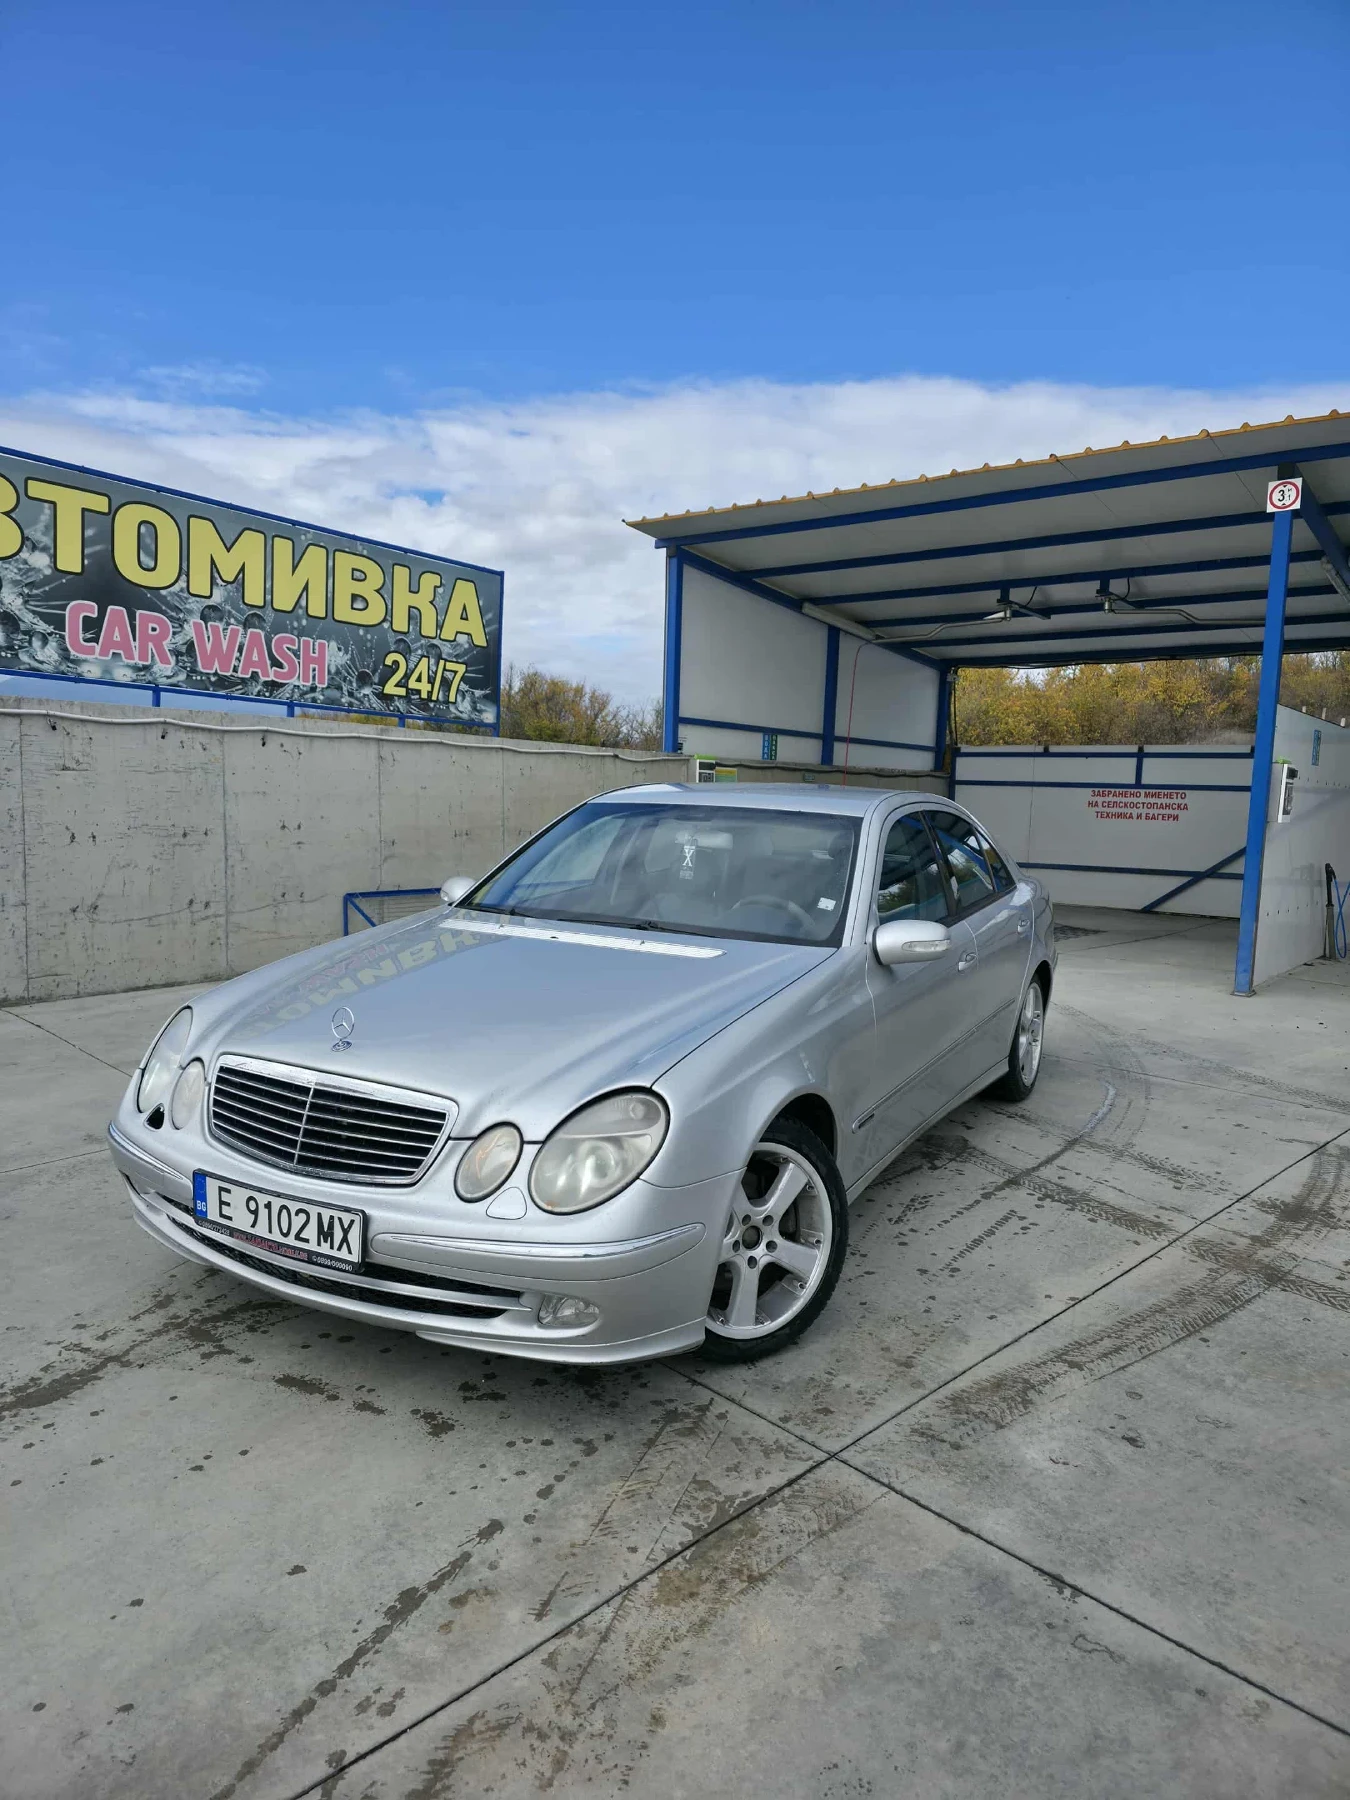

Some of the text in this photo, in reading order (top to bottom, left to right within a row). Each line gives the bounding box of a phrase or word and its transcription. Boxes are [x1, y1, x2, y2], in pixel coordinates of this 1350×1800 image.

[66, 600, 329, 687] CAR WASH
[382, 651, 467, 704] 24/7
[1091, 789, 1187, 800] ЗАБРАНЕНО МИЕНЕТО
[1087, 800, 1189, 811] НА СЕЛСКОСТОПАНСКА
[1095, 811, 1179, 822] ТЕХНИКА И БАГЕРИ
[196, 1200, 207, 1212] BG
[217, 1185, 233, 1221] E
[245, 1195, 311, 1243] 9102
[316, 1211, 355, 1255] MX
